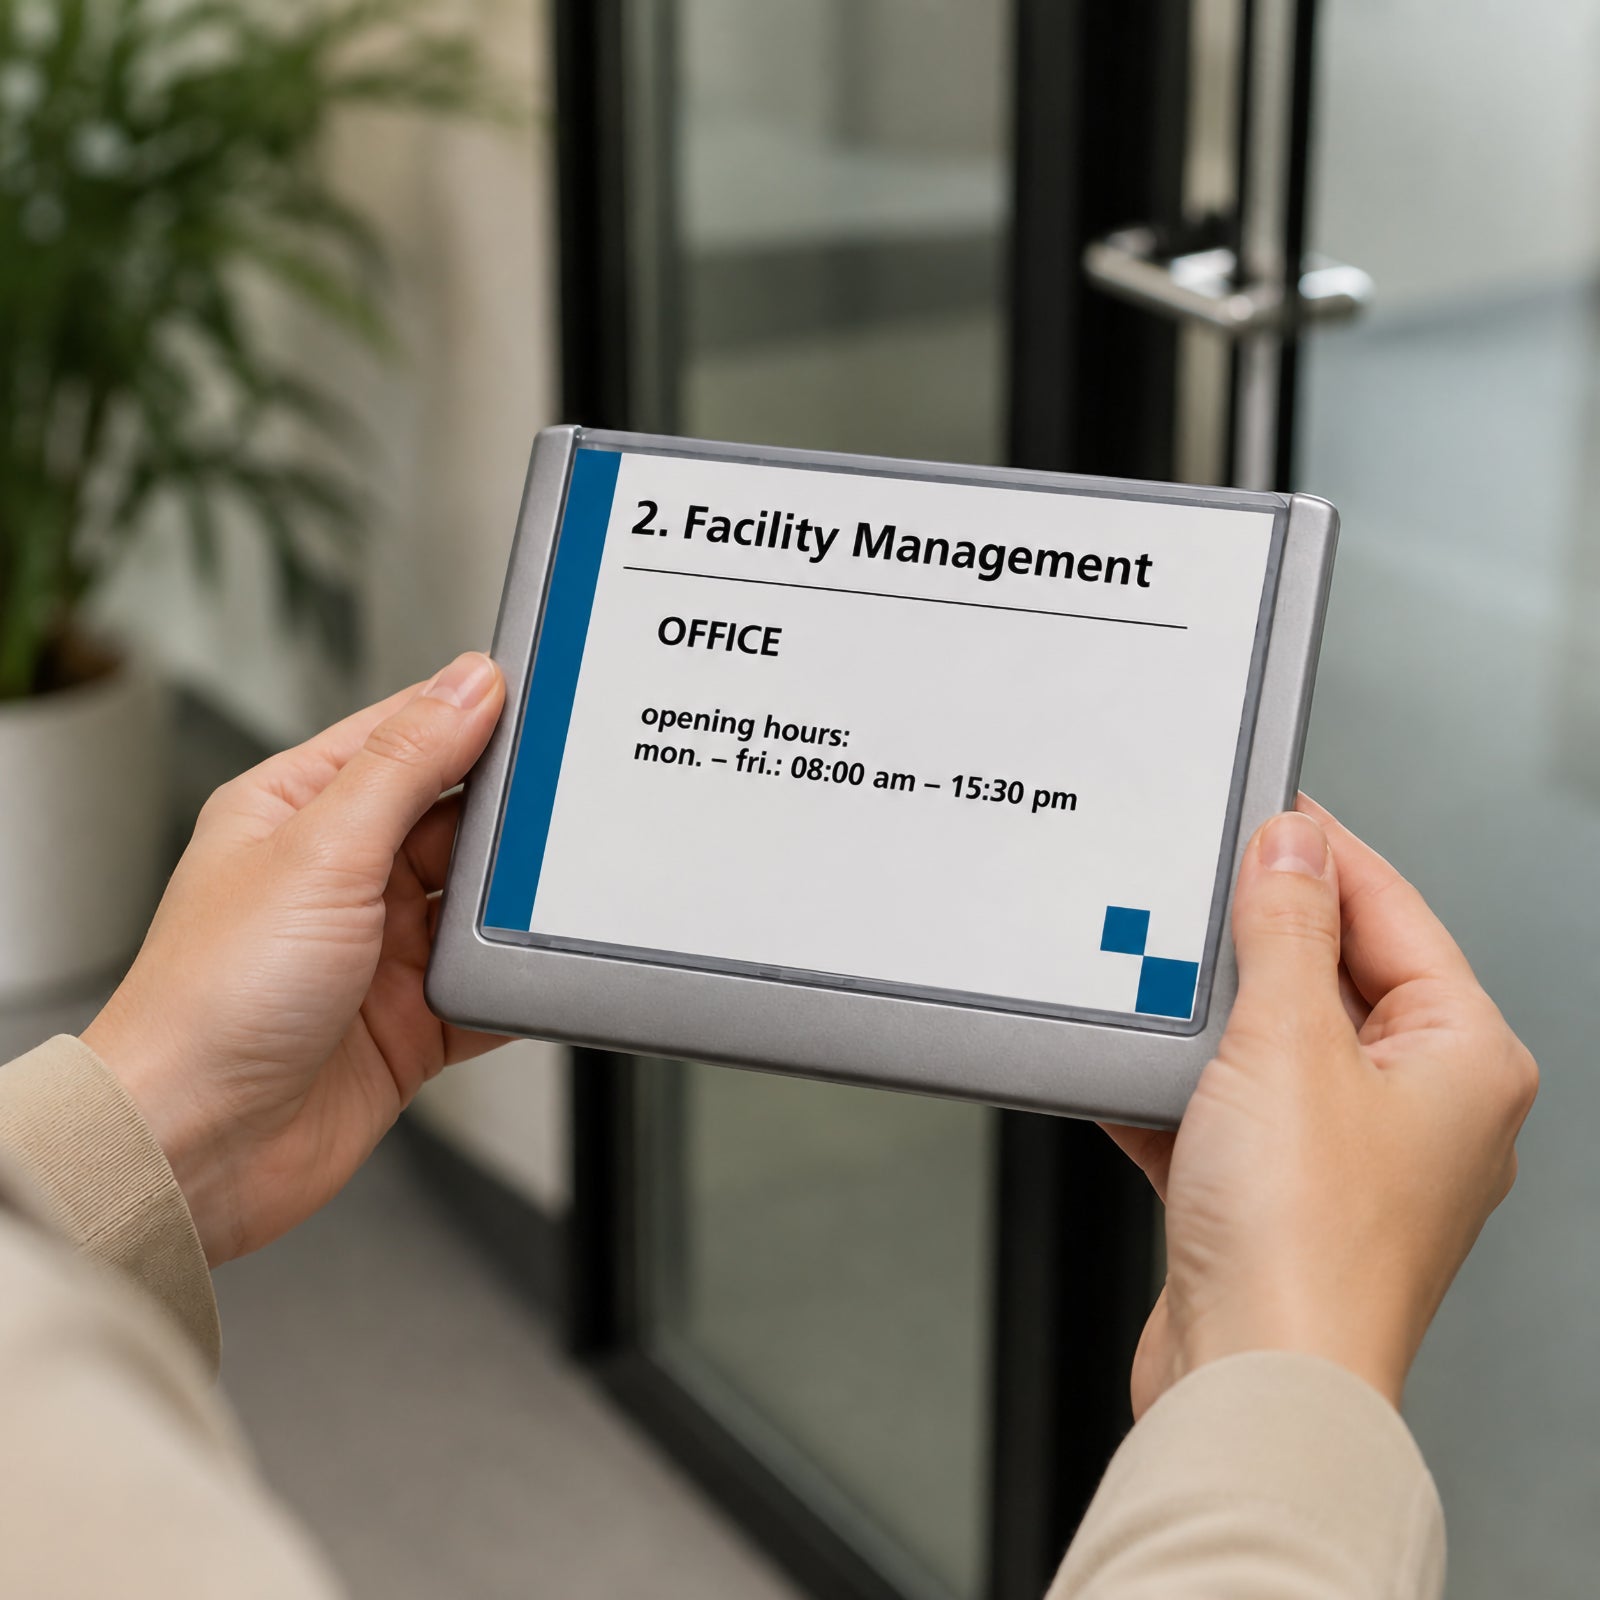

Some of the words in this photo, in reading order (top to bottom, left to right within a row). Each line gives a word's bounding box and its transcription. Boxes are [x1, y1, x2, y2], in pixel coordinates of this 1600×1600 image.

[631, 499, 668, 540] 2.
[683, 504, 840, 564] Facility
[852, 522, 1153, 588] Management
[657, 616, 783, 657] OFFICE
[641, 707, 756, 742] opening
[763, 714, 850, 748] hours:
[634, 742, 702, 768] mon.
[735, 747, 782, 777] fri.:
[790, 755, 865, 786] 08:00
[872, 771, 916, 792] am
[951, 774, 1025, 805] 15:30
[1031, 789, 1078, 814] pm
